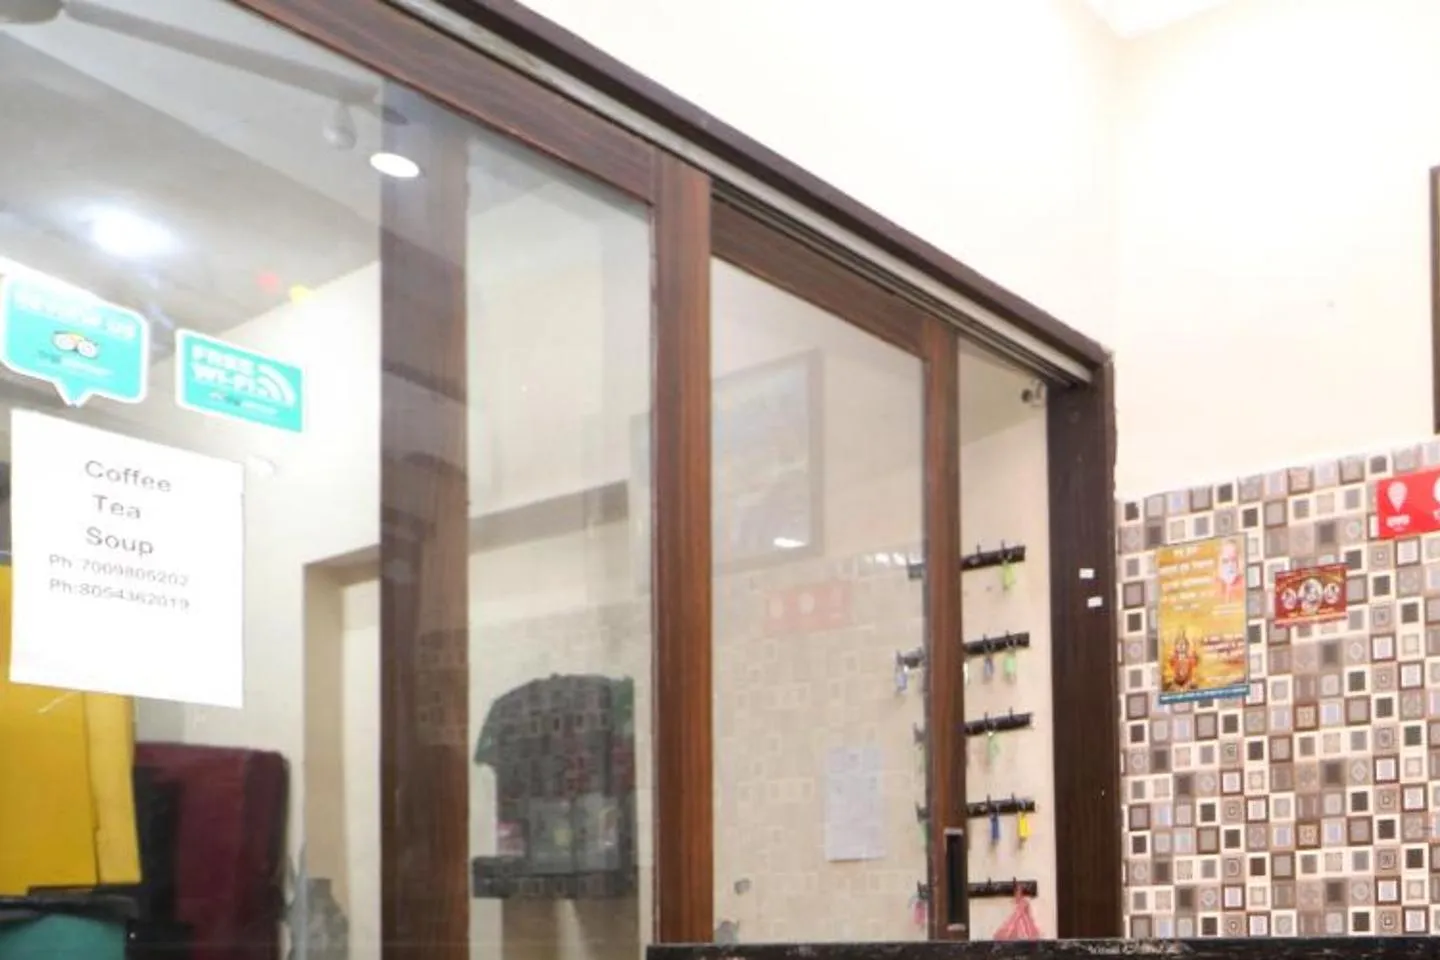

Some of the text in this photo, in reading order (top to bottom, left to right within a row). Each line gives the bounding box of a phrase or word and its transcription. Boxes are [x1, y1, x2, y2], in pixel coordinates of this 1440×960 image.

[84, 459, 173, 493] Coffee
[92, 494, 141, 520] Tea
[85, 525, 154, 557] Soup
